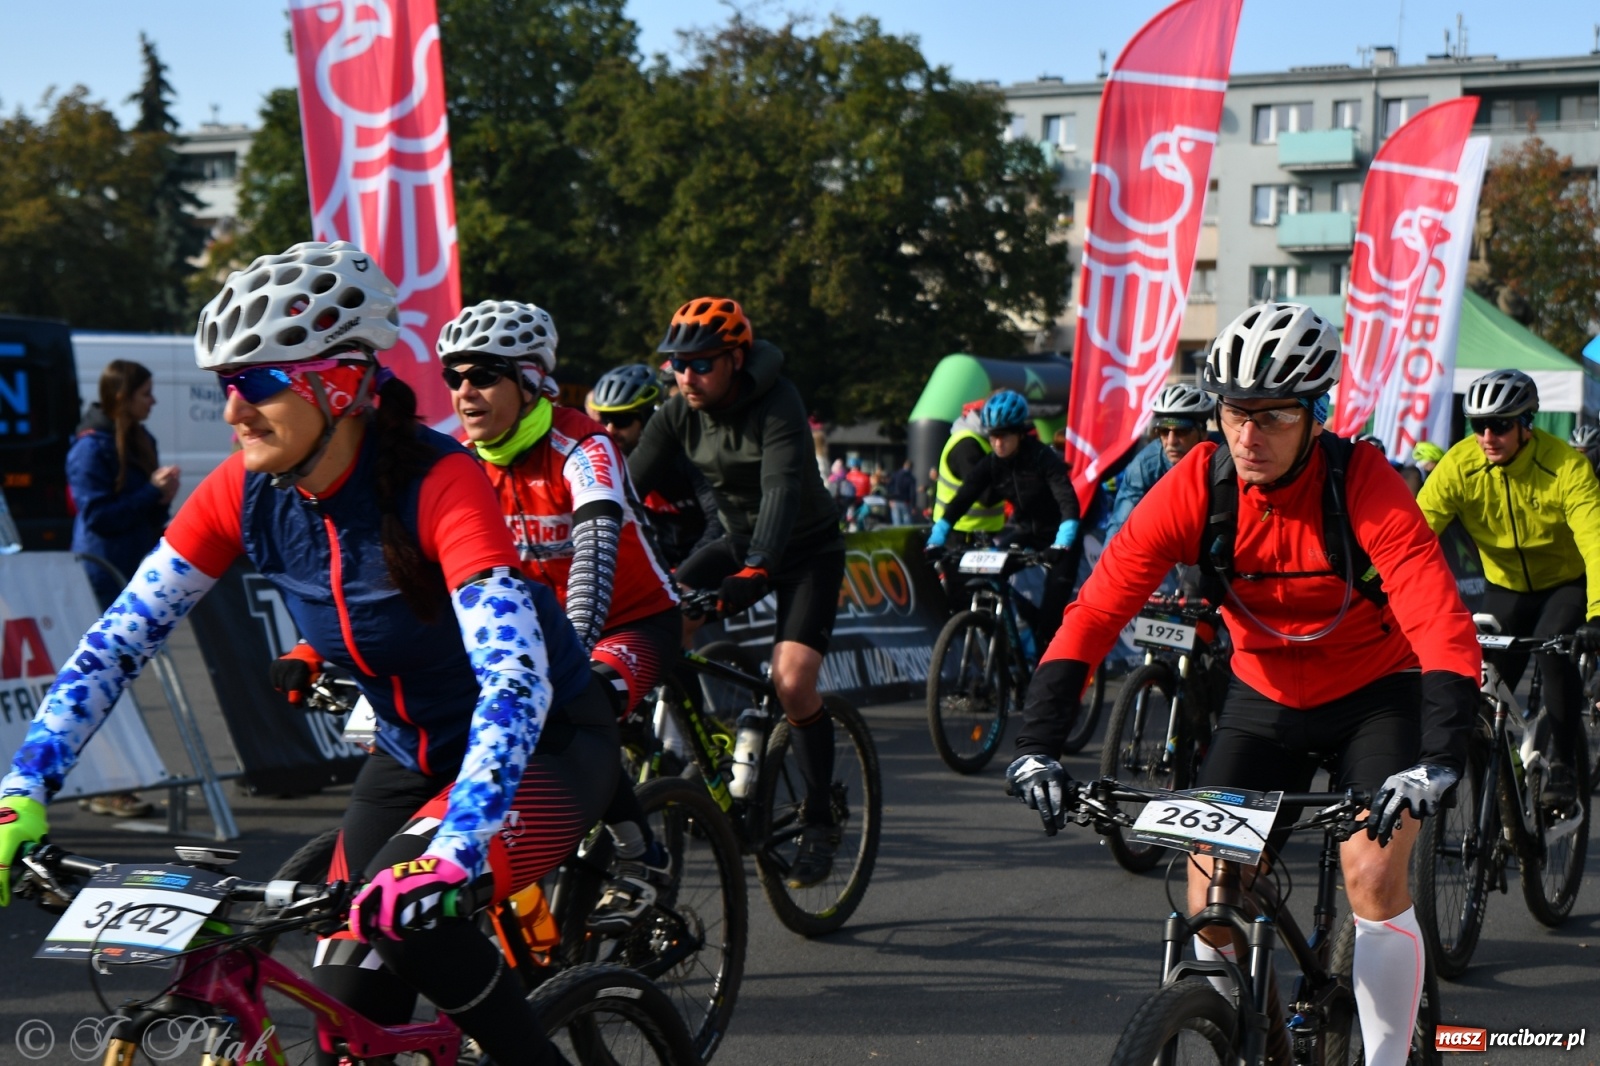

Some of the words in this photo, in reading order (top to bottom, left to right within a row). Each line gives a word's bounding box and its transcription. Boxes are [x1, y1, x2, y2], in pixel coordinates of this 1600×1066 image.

[1145, 623, 1185, 642] 1975
[1155, 806, 1249, 836] 2637
[391, 858, 438, 880] FLY
[84, 900, 184, 935] 3142
